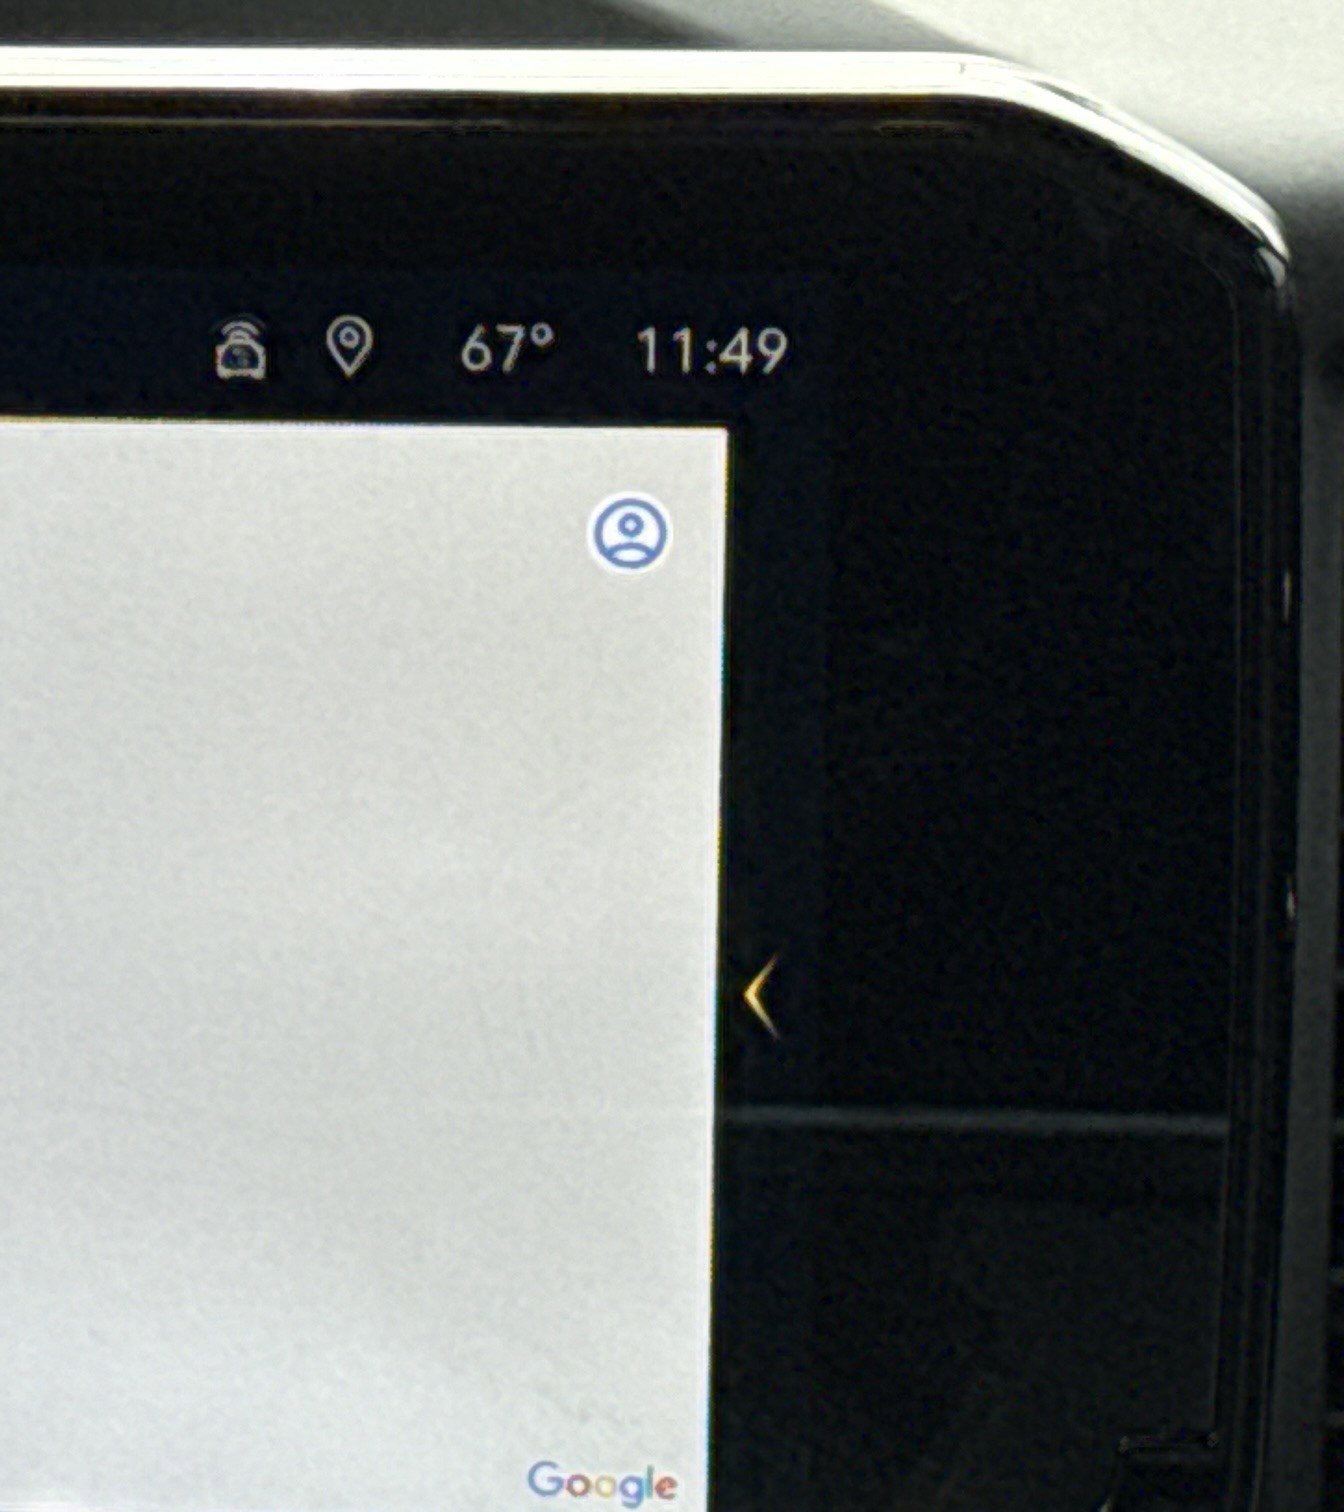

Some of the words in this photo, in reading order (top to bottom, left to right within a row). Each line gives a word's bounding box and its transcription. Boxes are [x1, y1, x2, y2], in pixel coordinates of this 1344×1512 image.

[461, 321, 555, 372] 67°
[637, 326, 788, 376] 11:49
[527, 1459, 679, 1509] Google
